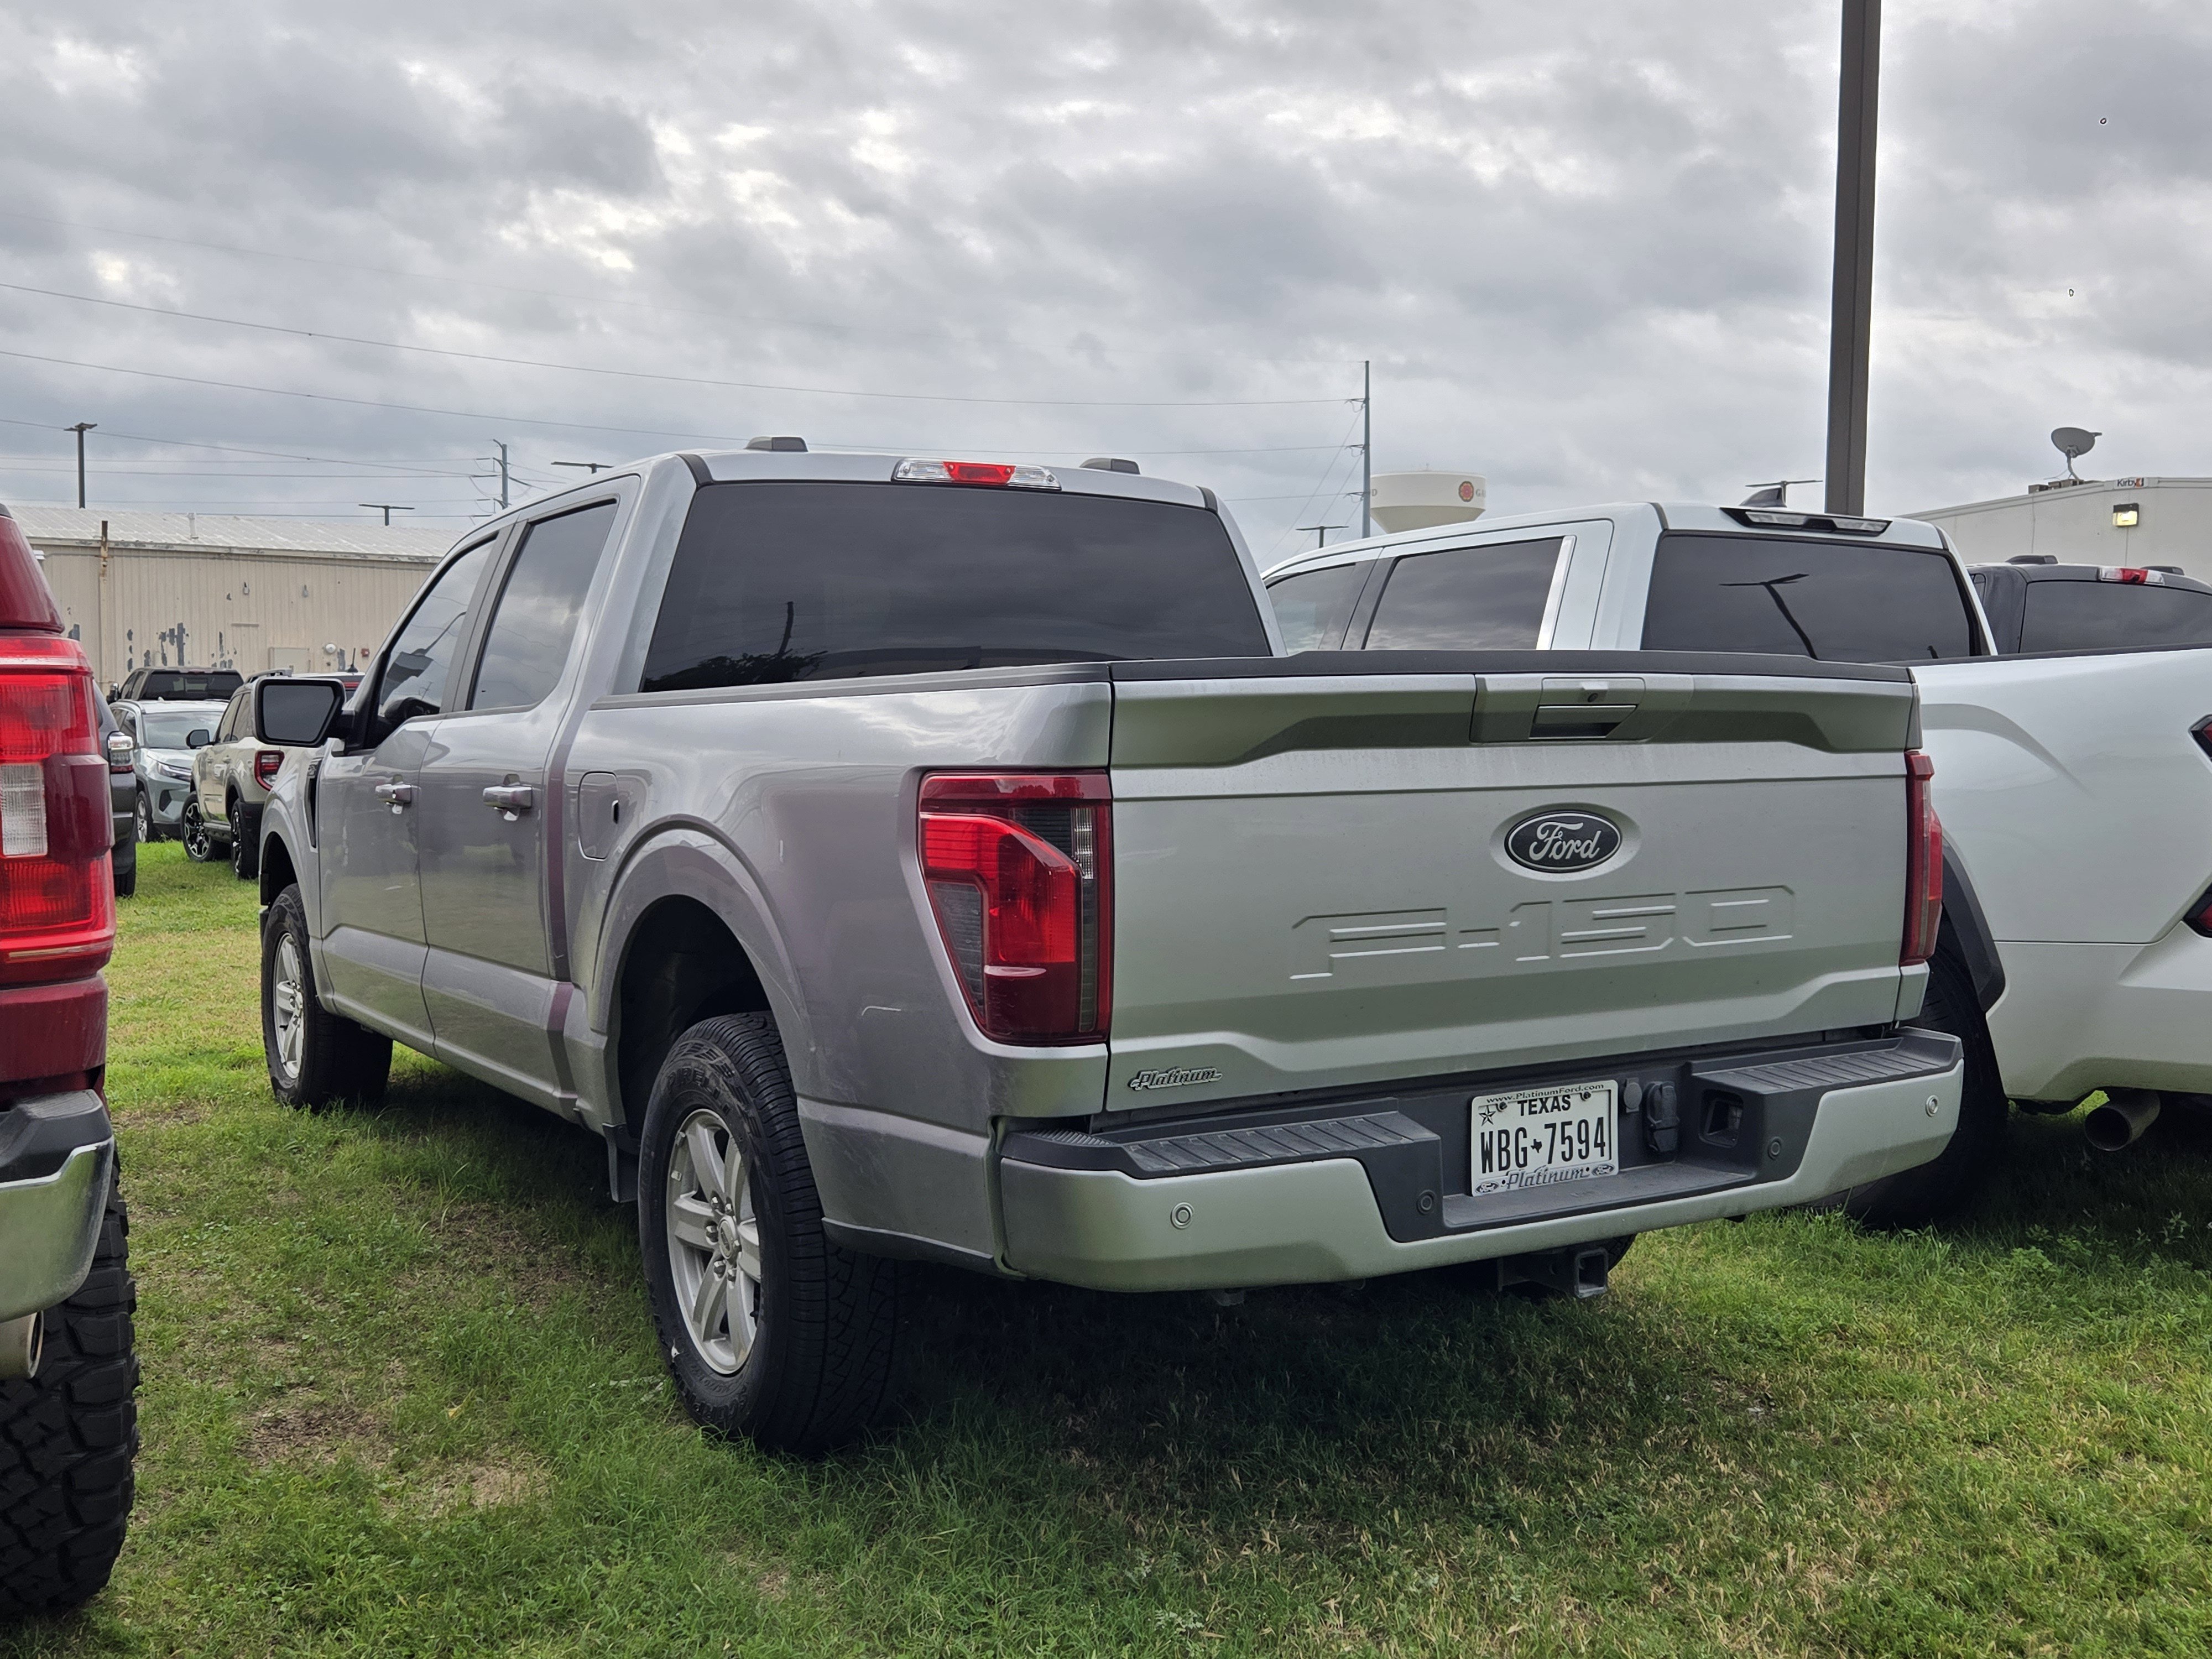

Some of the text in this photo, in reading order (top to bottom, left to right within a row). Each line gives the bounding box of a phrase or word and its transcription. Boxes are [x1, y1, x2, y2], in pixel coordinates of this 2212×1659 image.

[1529, 821, 1601, 860] Ford
[1290, 885, 1796, 979] F-150
[1128, 1066, 1223, 1091] Platinum
[1486, 1084, 1604, 1103] www.PlatinumFord.com
[1517, 1094, 1571, 1117] TEXAS
[1480, 1117, 1605, 1174] WBG 7594
[1506, 1165, 1590, 1190] Platinum
